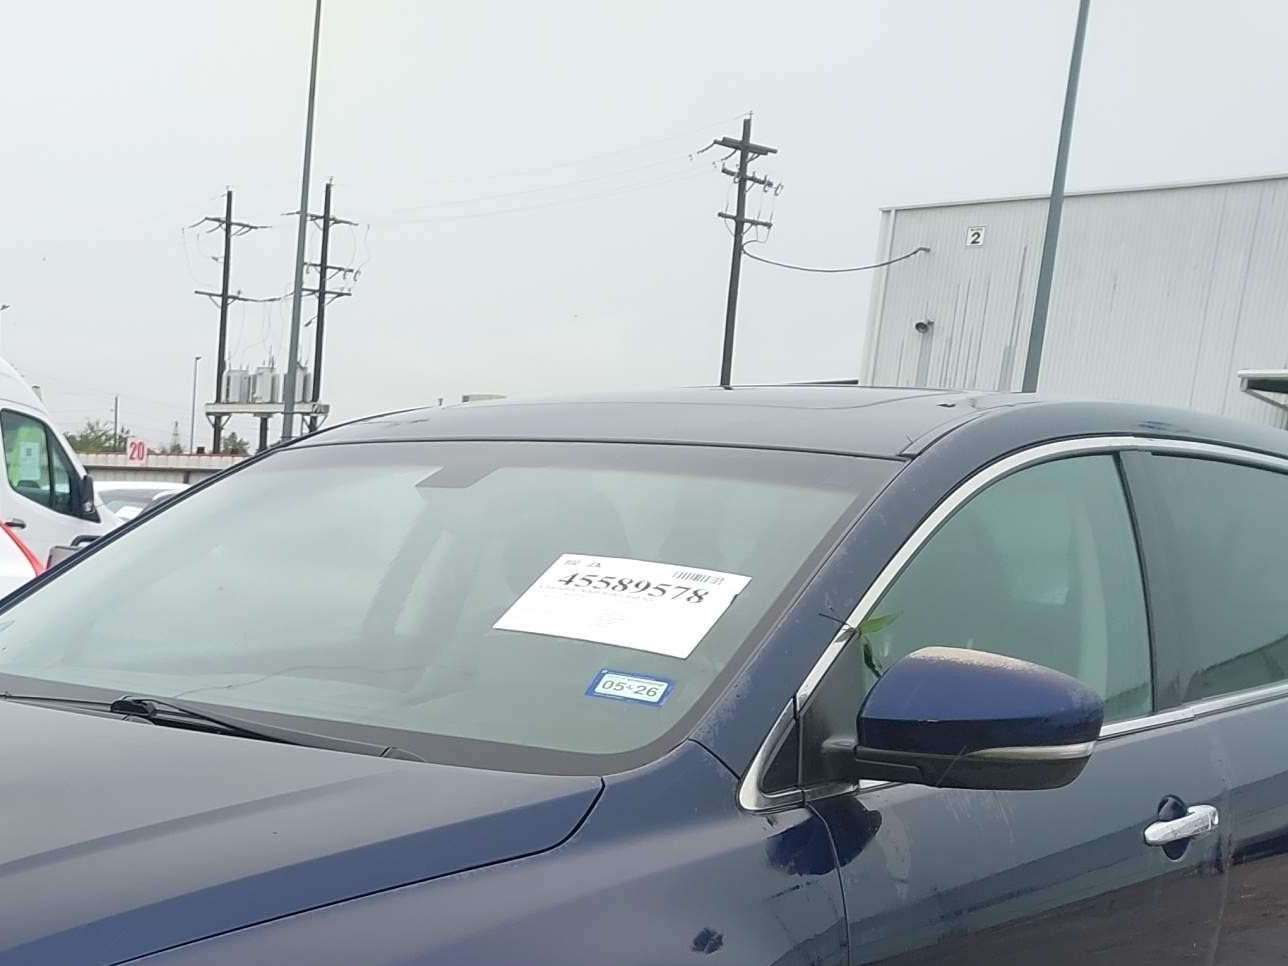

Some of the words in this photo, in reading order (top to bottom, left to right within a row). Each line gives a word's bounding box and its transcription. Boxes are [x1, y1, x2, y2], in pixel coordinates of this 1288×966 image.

[971, 232, 981, 245] 2
[129, 442, 144, 460] 20
[558, 573, 709, 603] 45589578
